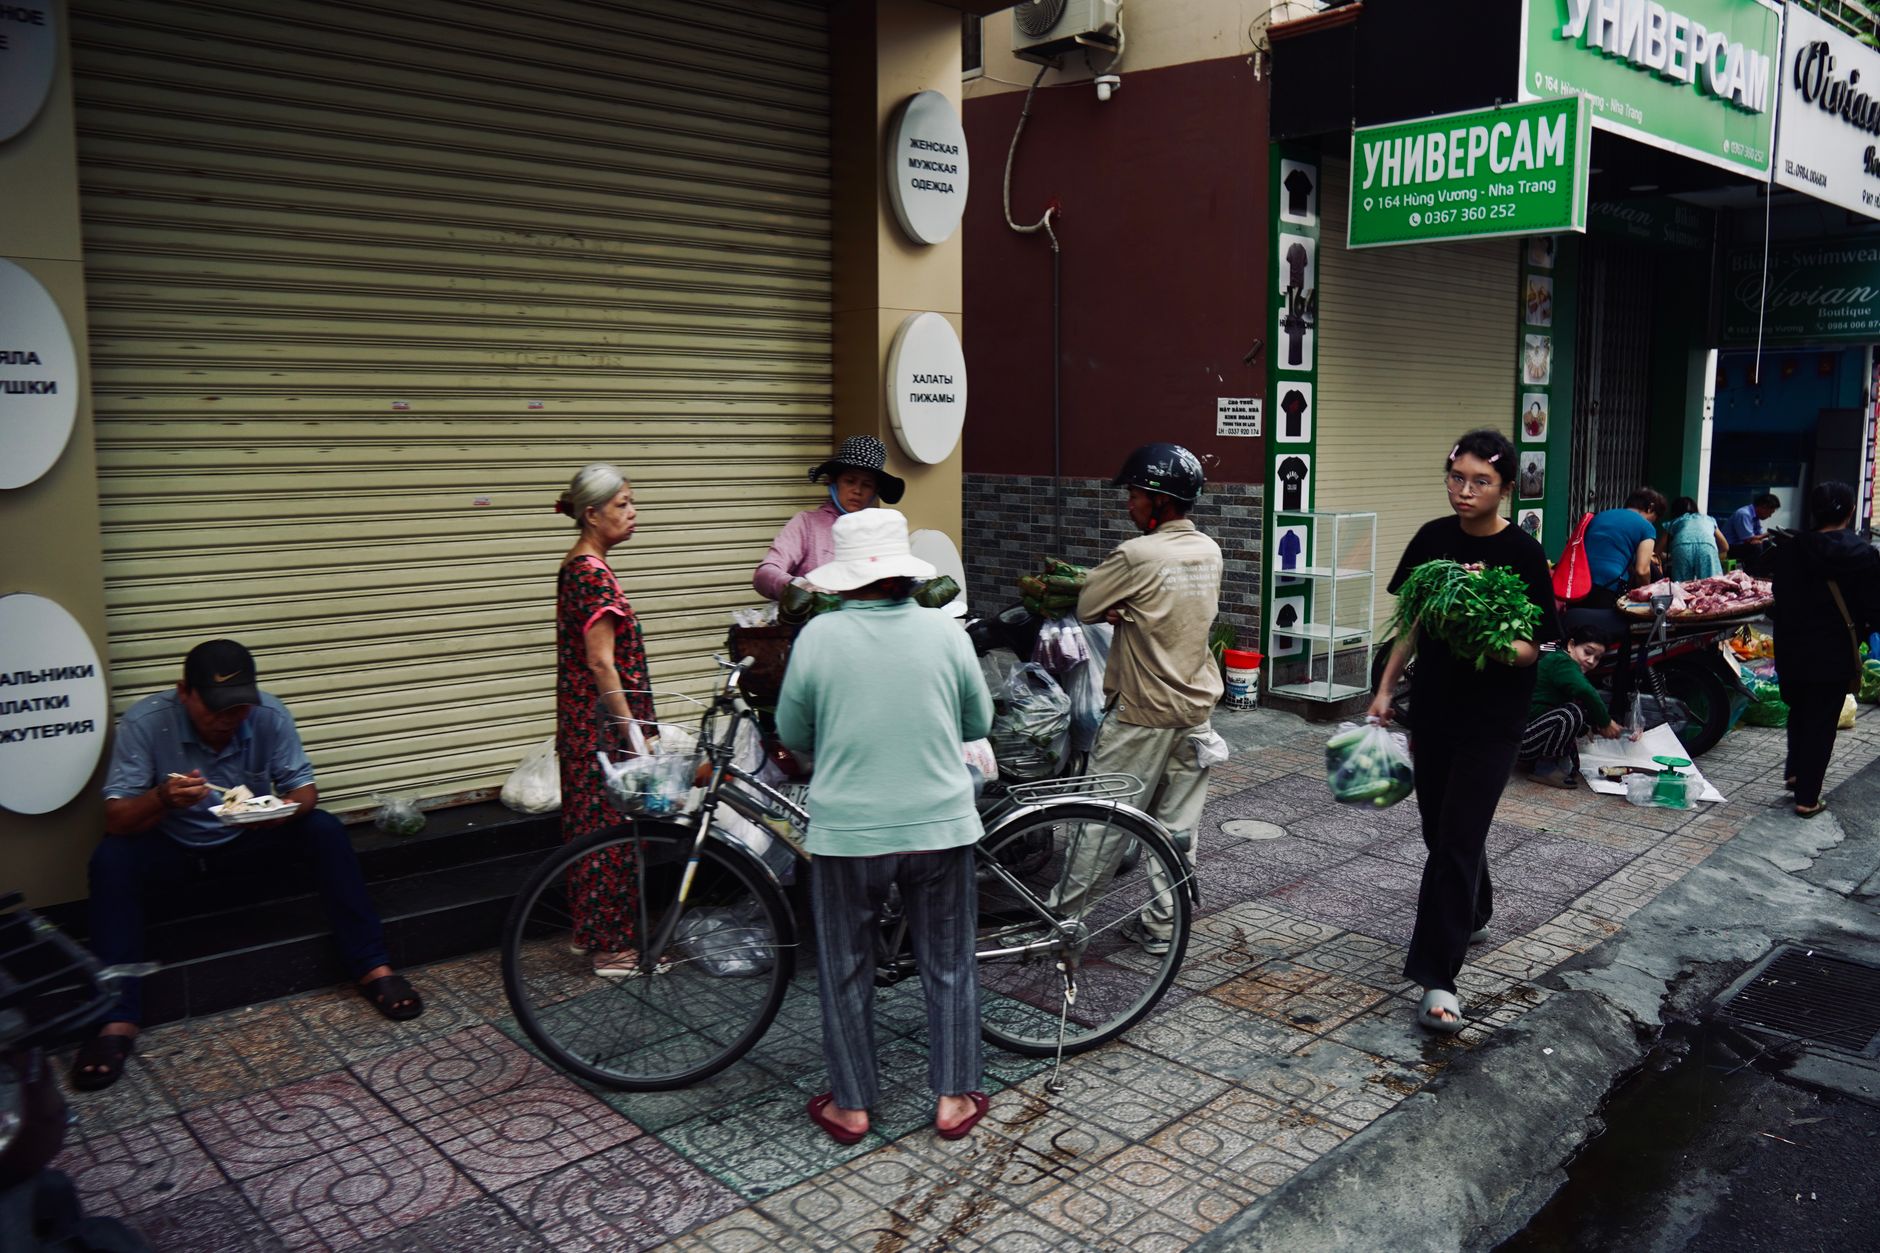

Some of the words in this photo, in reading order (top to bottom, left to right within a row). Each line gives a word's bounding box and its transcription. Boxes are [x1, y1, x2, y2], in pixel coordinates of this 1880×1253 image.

[1563, 0, 1769, 113] УНИВЕРСАМ
[1611, 98, 1624, 116] Nha
[1625, 104, 1643, 124] Trang
[910, 138, 959, 155] ЖЕНСКАЯ
[1362, 112, 1567, 190] УНИВЕРСАМ
[908, 158, 958, 174] МУЖСКАЯ
[911, 178, 954, 194] ОДЕЖДА
[1378, 195, 1401, 209] 164
[1404, 192, 1435, 208] Hùng
[1438, 187, 1478, 203] Vương
[1489, 183, 1515, 199] Nha
[1518, 180, 1557, 195] Trang
[1424, 209, 1457, 225] 0367
[1461, 206, 1487, 222] 360
[1490, 203, 1517, 219] 252
[1791, 248, 1880, 267] Swimwea
[1818, 306, 1872, 318] Boutique
[1868, 320, 1880, 328] 87
[912, 374, 953, 384] ХАЛАТЫ
[910, 393, 955, 403] ПИЖАМЫ
